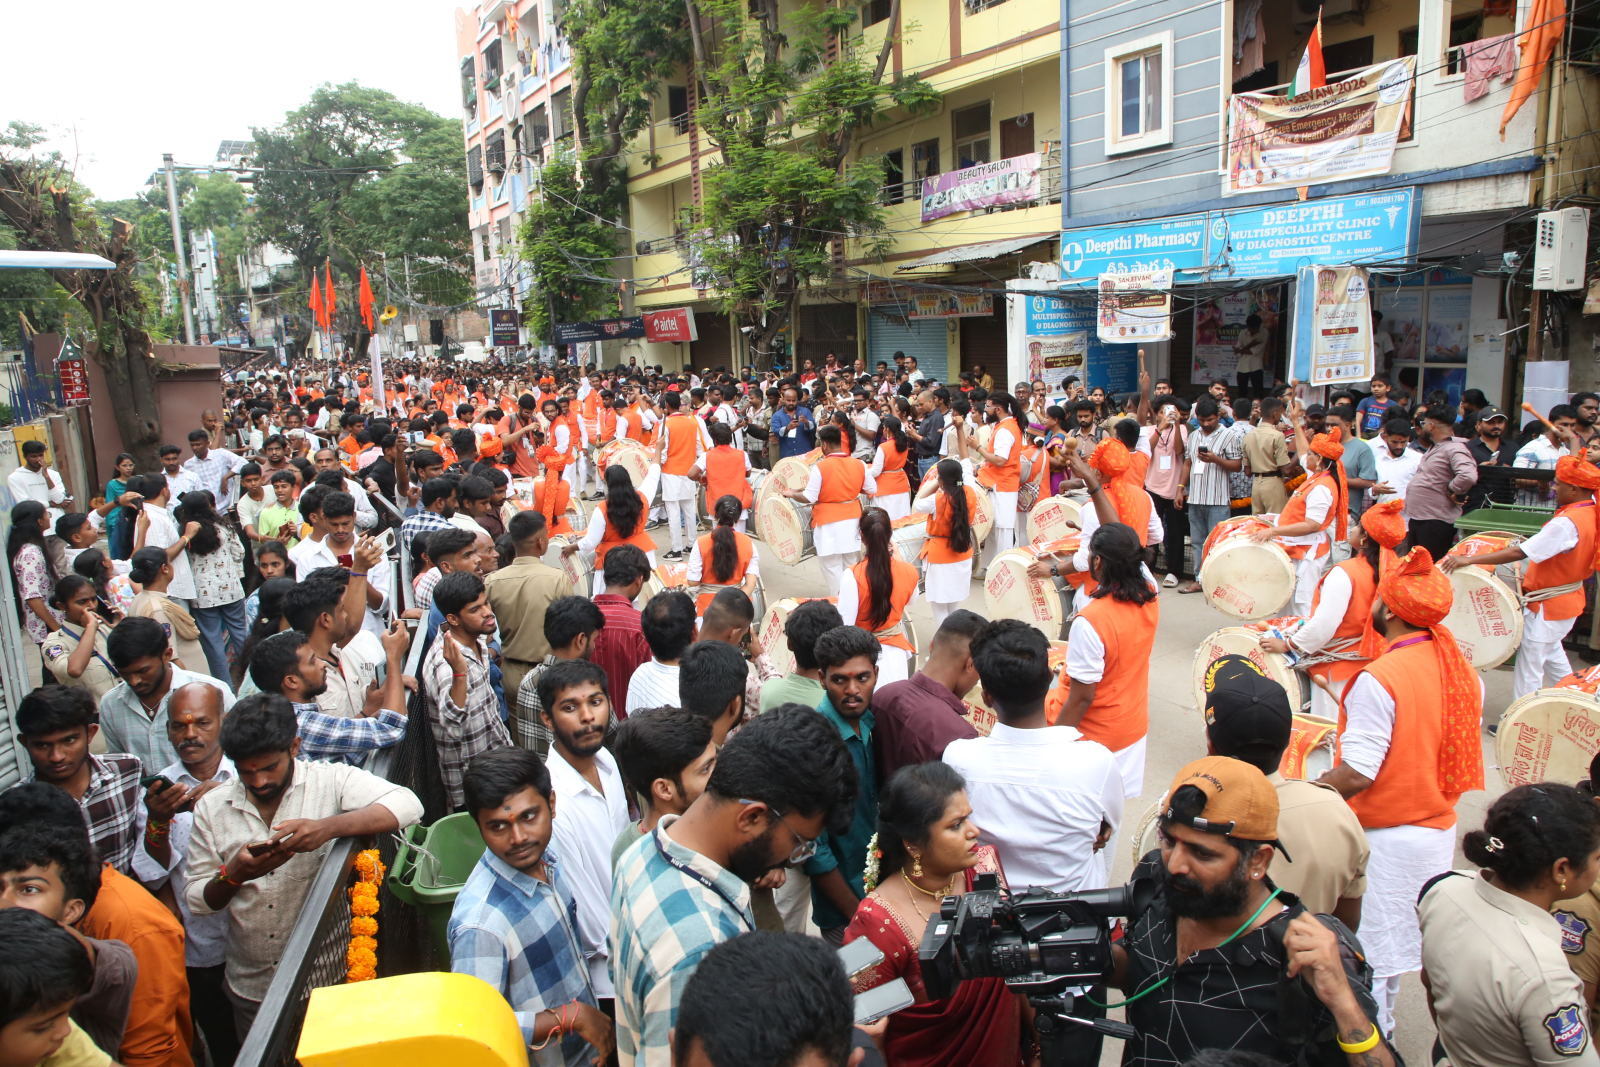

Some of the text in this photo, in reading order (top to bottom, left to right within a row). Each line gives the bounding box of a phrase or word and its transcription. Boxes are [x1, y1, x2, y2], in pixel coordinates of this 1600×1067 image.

[1335, 77, 1368, 94] 2026
[1291, 114, 1337, 132] Emergency
[957, 160, 1012, 181] BEAUTY SALON
[1263, 203, 1344, 226] DEEPTHI
[1231, 216, 1381, 240] MULTISPECIALITY CLINIC
[1086, 231, 1201, 255] Deepthi Pharmacy
[1236, 230, 1373, 251] & DIAGNOSTIC CENTRE
[1118, 274, 1151, 284] SANJEEVANI
[660, 316, 678, 332] airtel
[1032, 311, 1088, 321] MULTISPECIALITY
[1043, 320, 1083, 330] DIAGNOSTIC
[1561, 930, 1582, 943] LICE
[1555, 1022, 1584, 1042] POLICE
